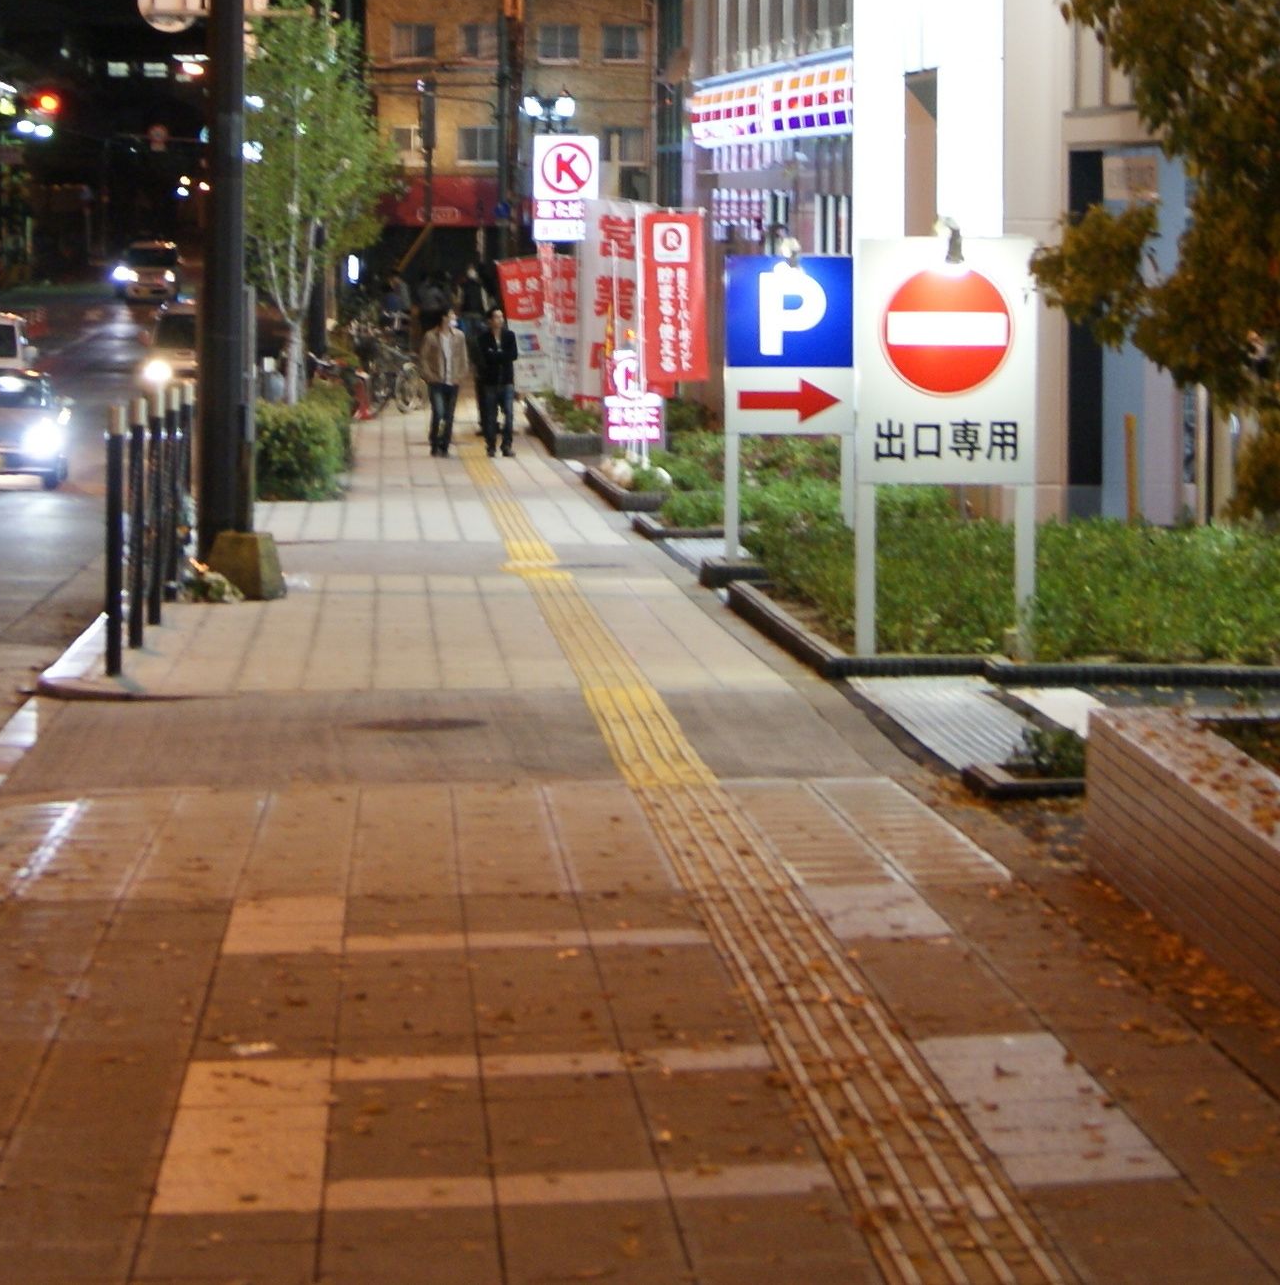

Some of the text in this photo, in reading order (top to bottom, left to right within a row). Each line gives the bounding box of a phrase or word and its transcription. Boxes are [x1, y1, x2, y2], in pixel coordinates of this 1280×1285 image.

[759, 271, 827, 356] P
[874, 418, 1019, 462] 出口専用
